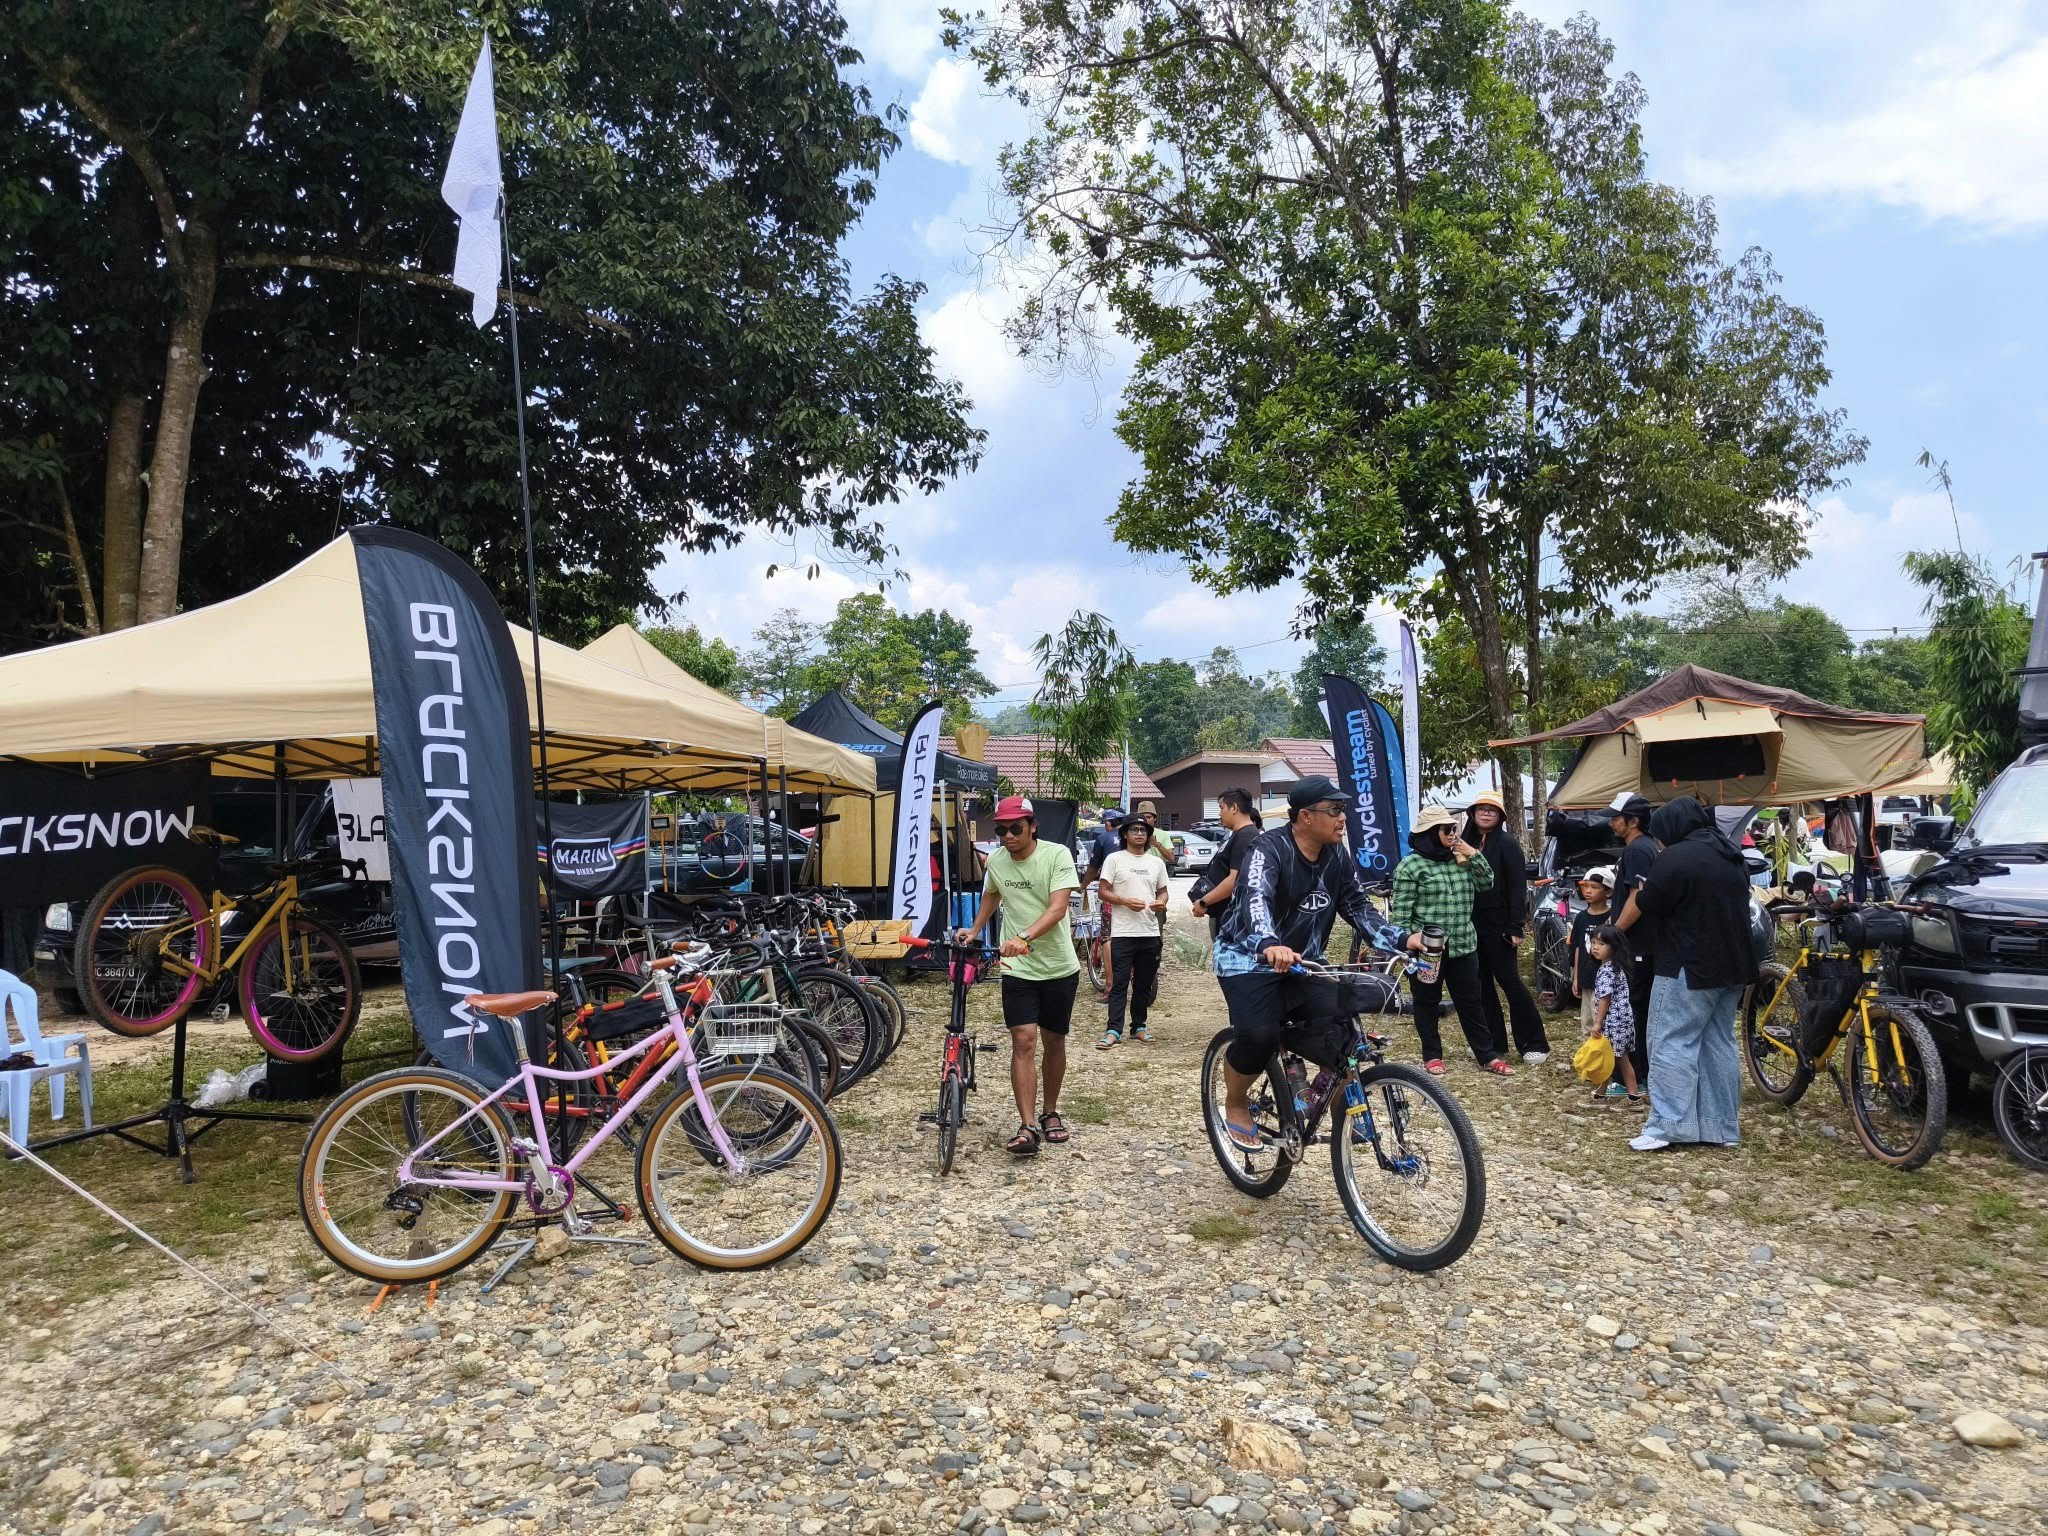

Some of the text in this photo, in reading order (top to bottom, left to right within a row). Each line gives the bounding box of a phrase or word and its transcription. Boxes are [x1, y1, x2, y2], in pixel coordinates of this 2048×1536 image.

[1360, 708, 1377, 779] tuned by cyclist
[0, 806, 195, 855] CKSNOW
[556, 848, 607, 864] MARIN
